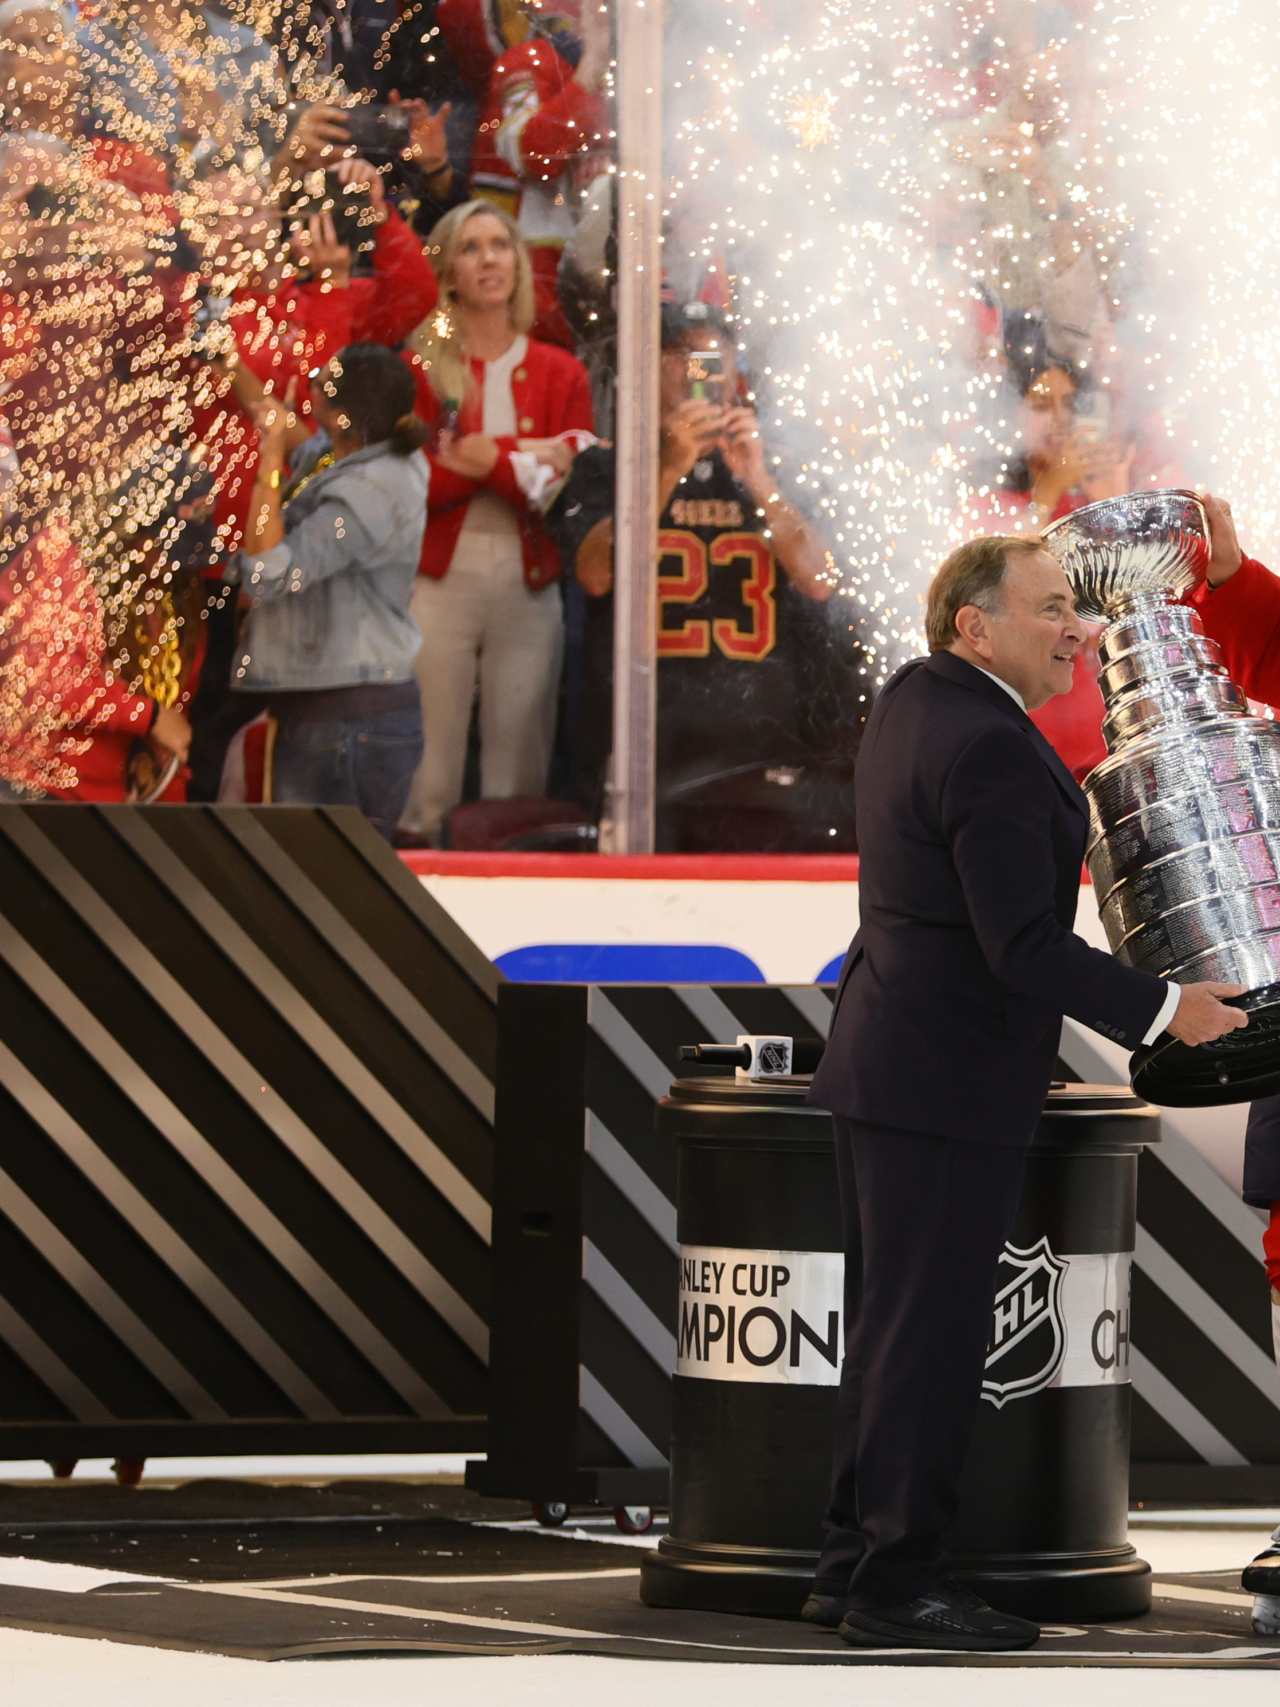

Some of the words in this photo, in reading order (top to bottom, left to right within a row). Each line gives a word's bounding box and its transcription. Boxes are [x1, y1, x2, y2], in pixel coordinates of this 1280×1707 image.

[656, 529, 776, 663] 23
[732, 1264, 790, 1297] CUP
[989, 1280, 1044, 1350] HL
[677, 1300, 839, 1368] MPION
